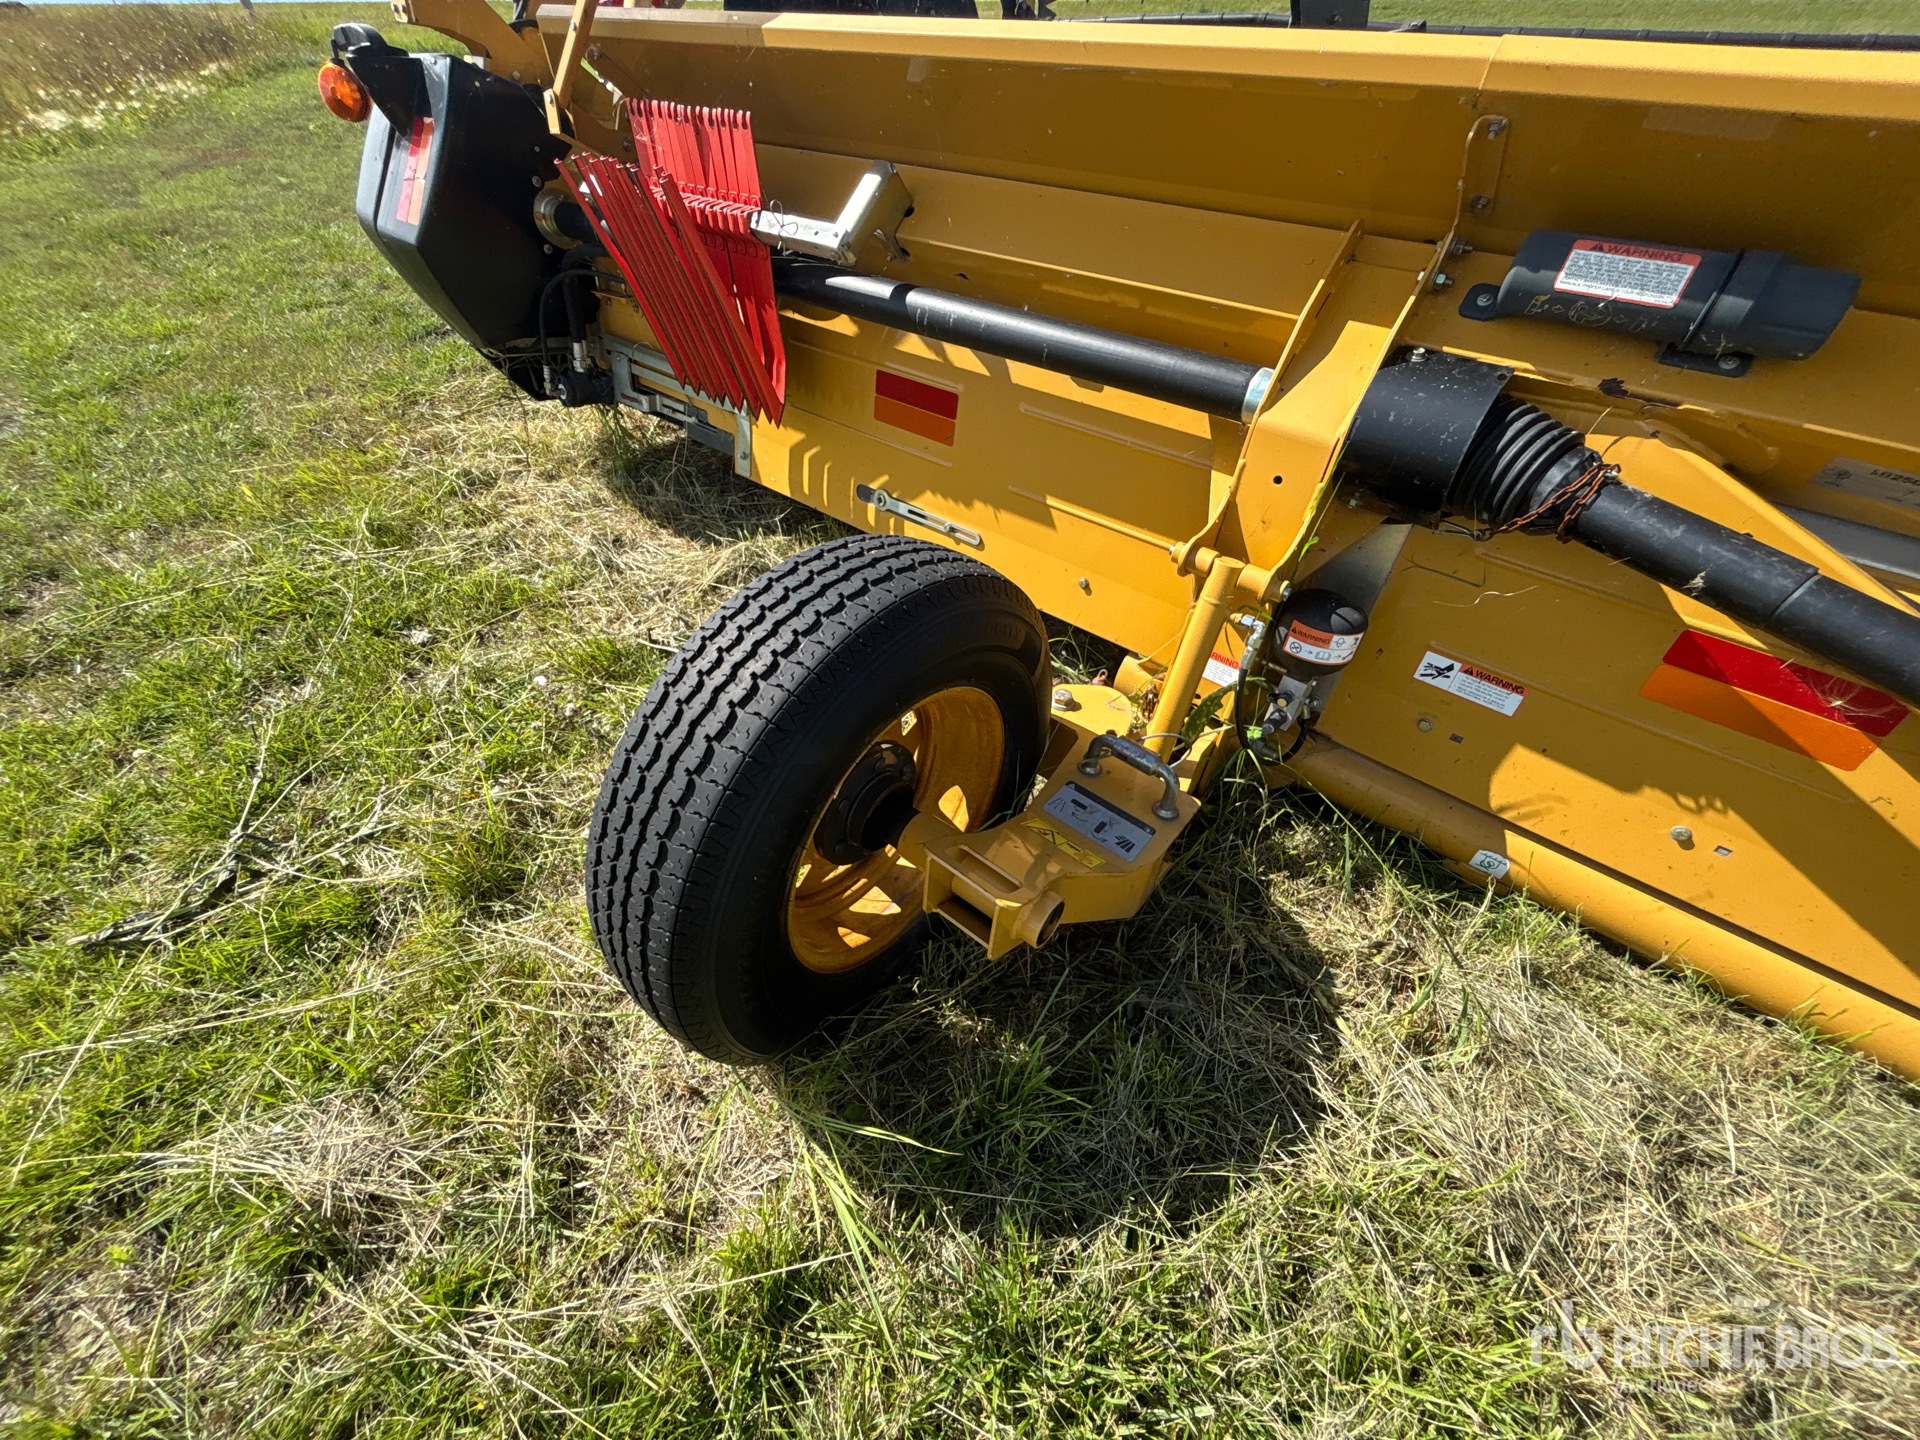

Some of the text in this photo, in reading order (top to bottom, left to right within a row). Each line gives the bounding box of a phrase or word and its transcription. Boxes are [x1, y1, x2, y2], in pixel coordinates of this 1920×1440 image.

[1608, 244, 1682, 262] WARNING
[1297, 629, 1330, 645] WARNING
[1475, 669, 1525, 695] WARNING
